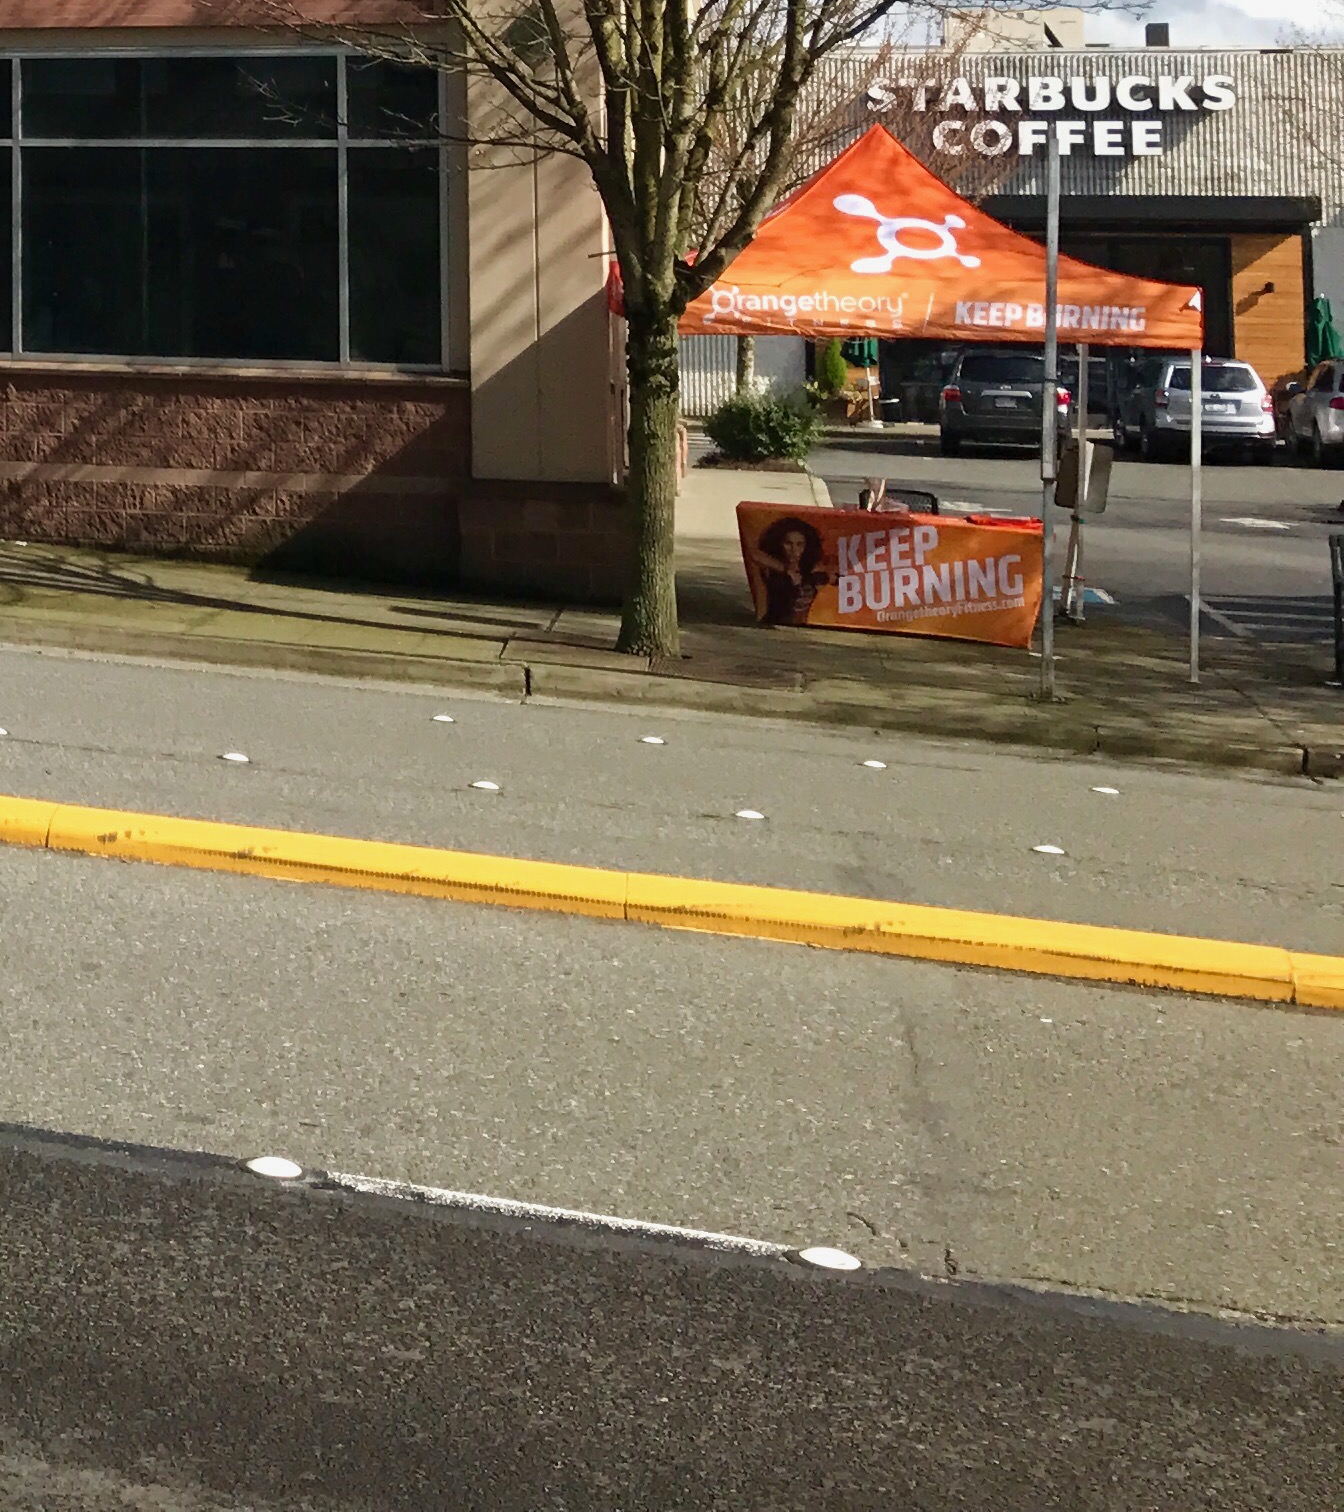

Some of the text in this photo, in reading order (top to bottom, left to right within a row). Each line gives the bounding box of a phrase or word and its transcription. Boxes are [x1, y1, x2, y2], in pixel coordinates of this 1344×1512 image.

[866, 75, 1236, 112] STARBUCKS
[932, 120, 1163, 156] COFFEE
[955, 301, 1023, 327] KEEP
[837, 525, 938, 575] KEEP
[838, 554, 1024, 614] BURNING
